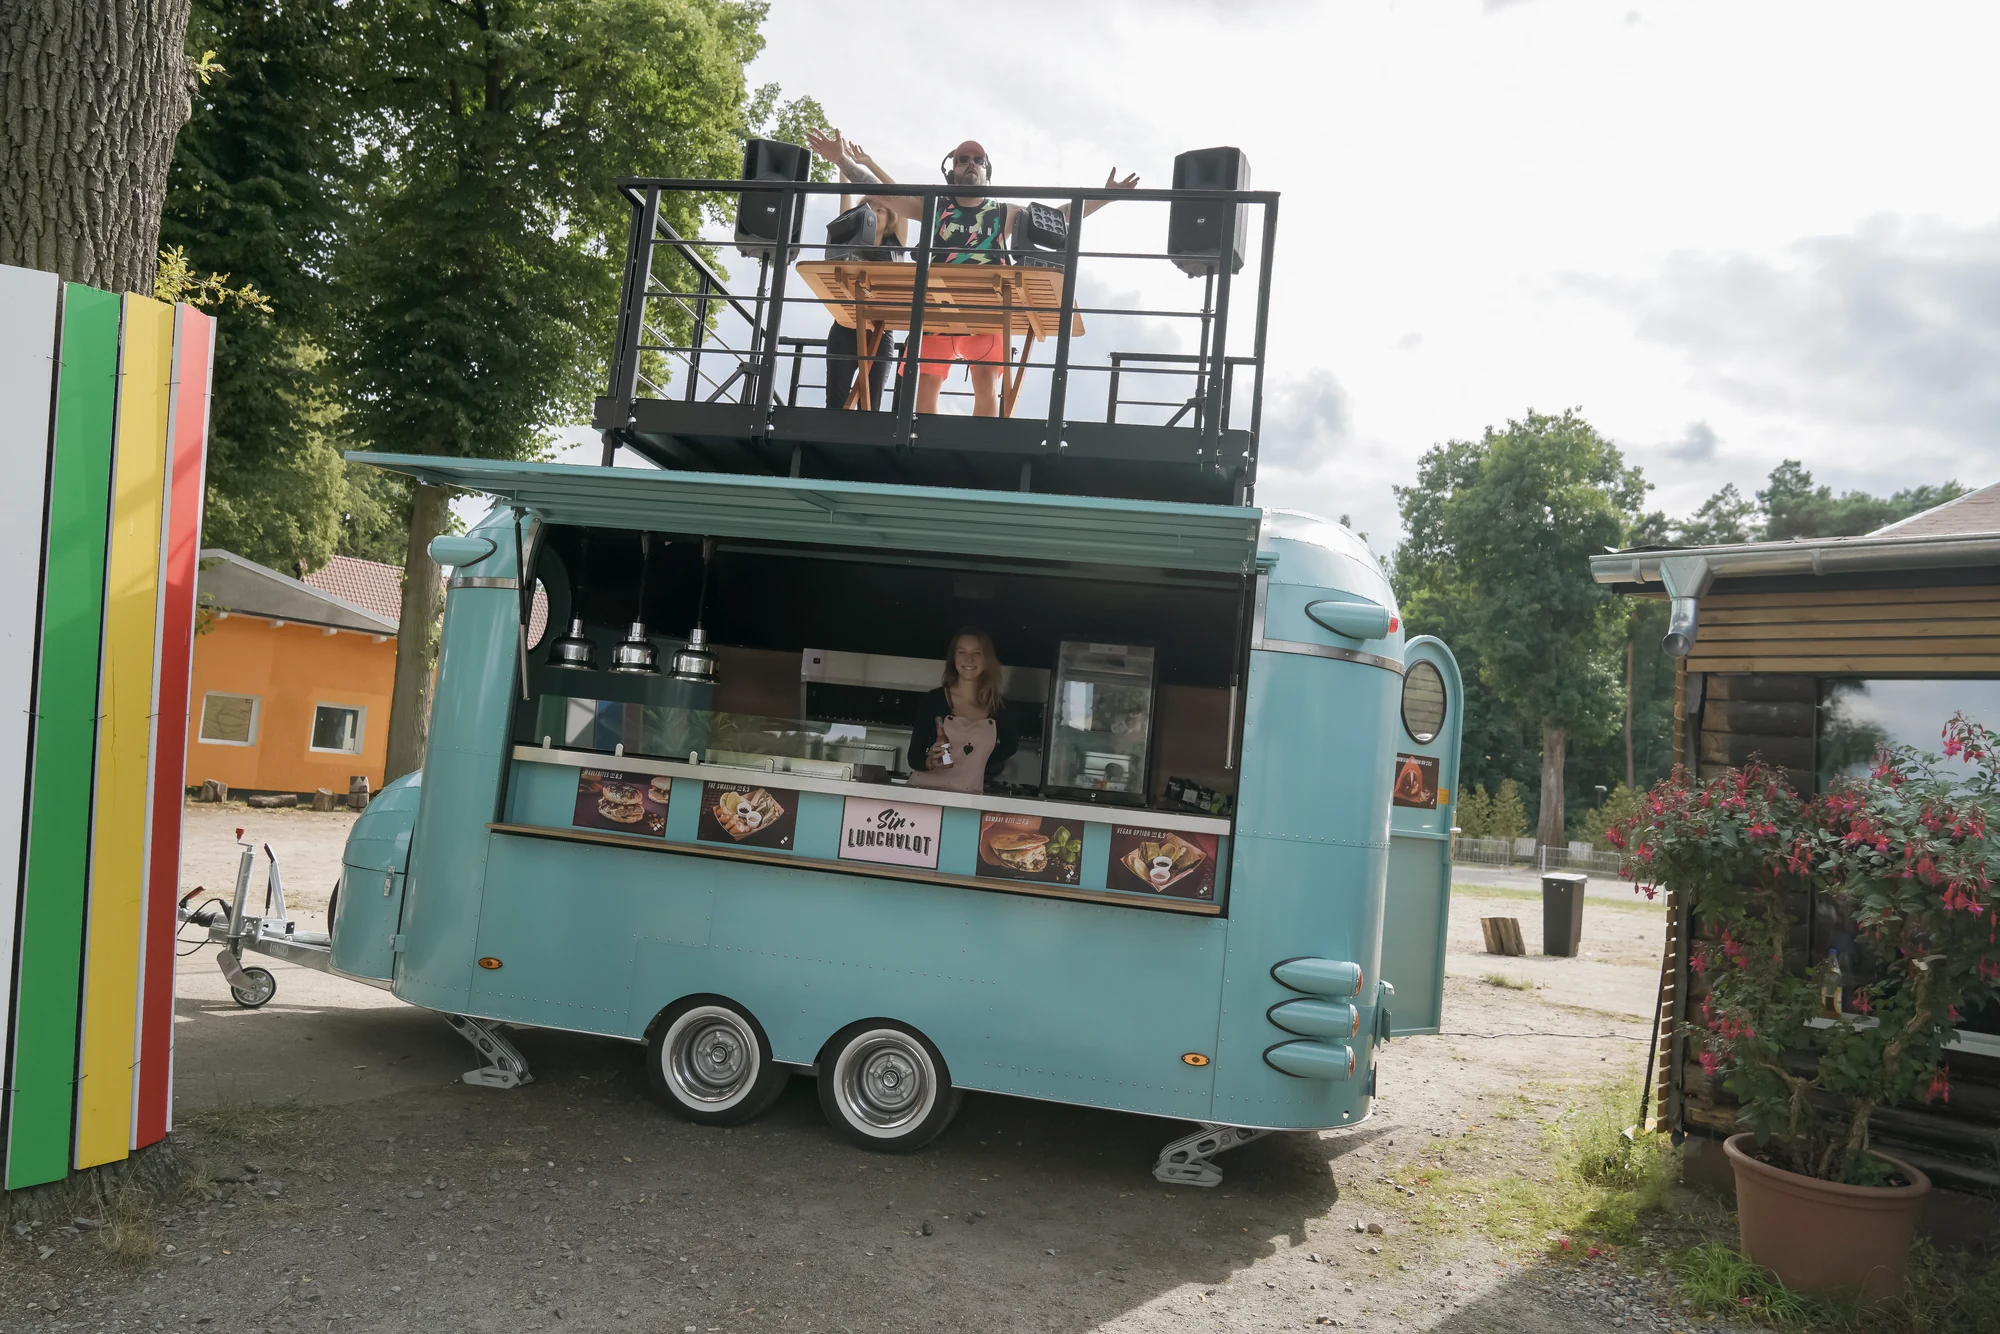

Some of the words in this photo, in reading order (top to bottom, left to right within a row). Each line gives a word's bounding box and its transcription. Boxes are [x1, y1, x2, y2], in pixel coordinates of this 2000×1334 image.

[876, 808, 906, 831] Sir
[1116, 827, 1133, 835] VEGAN
[1132, 829, 1151, 837] OPTION
